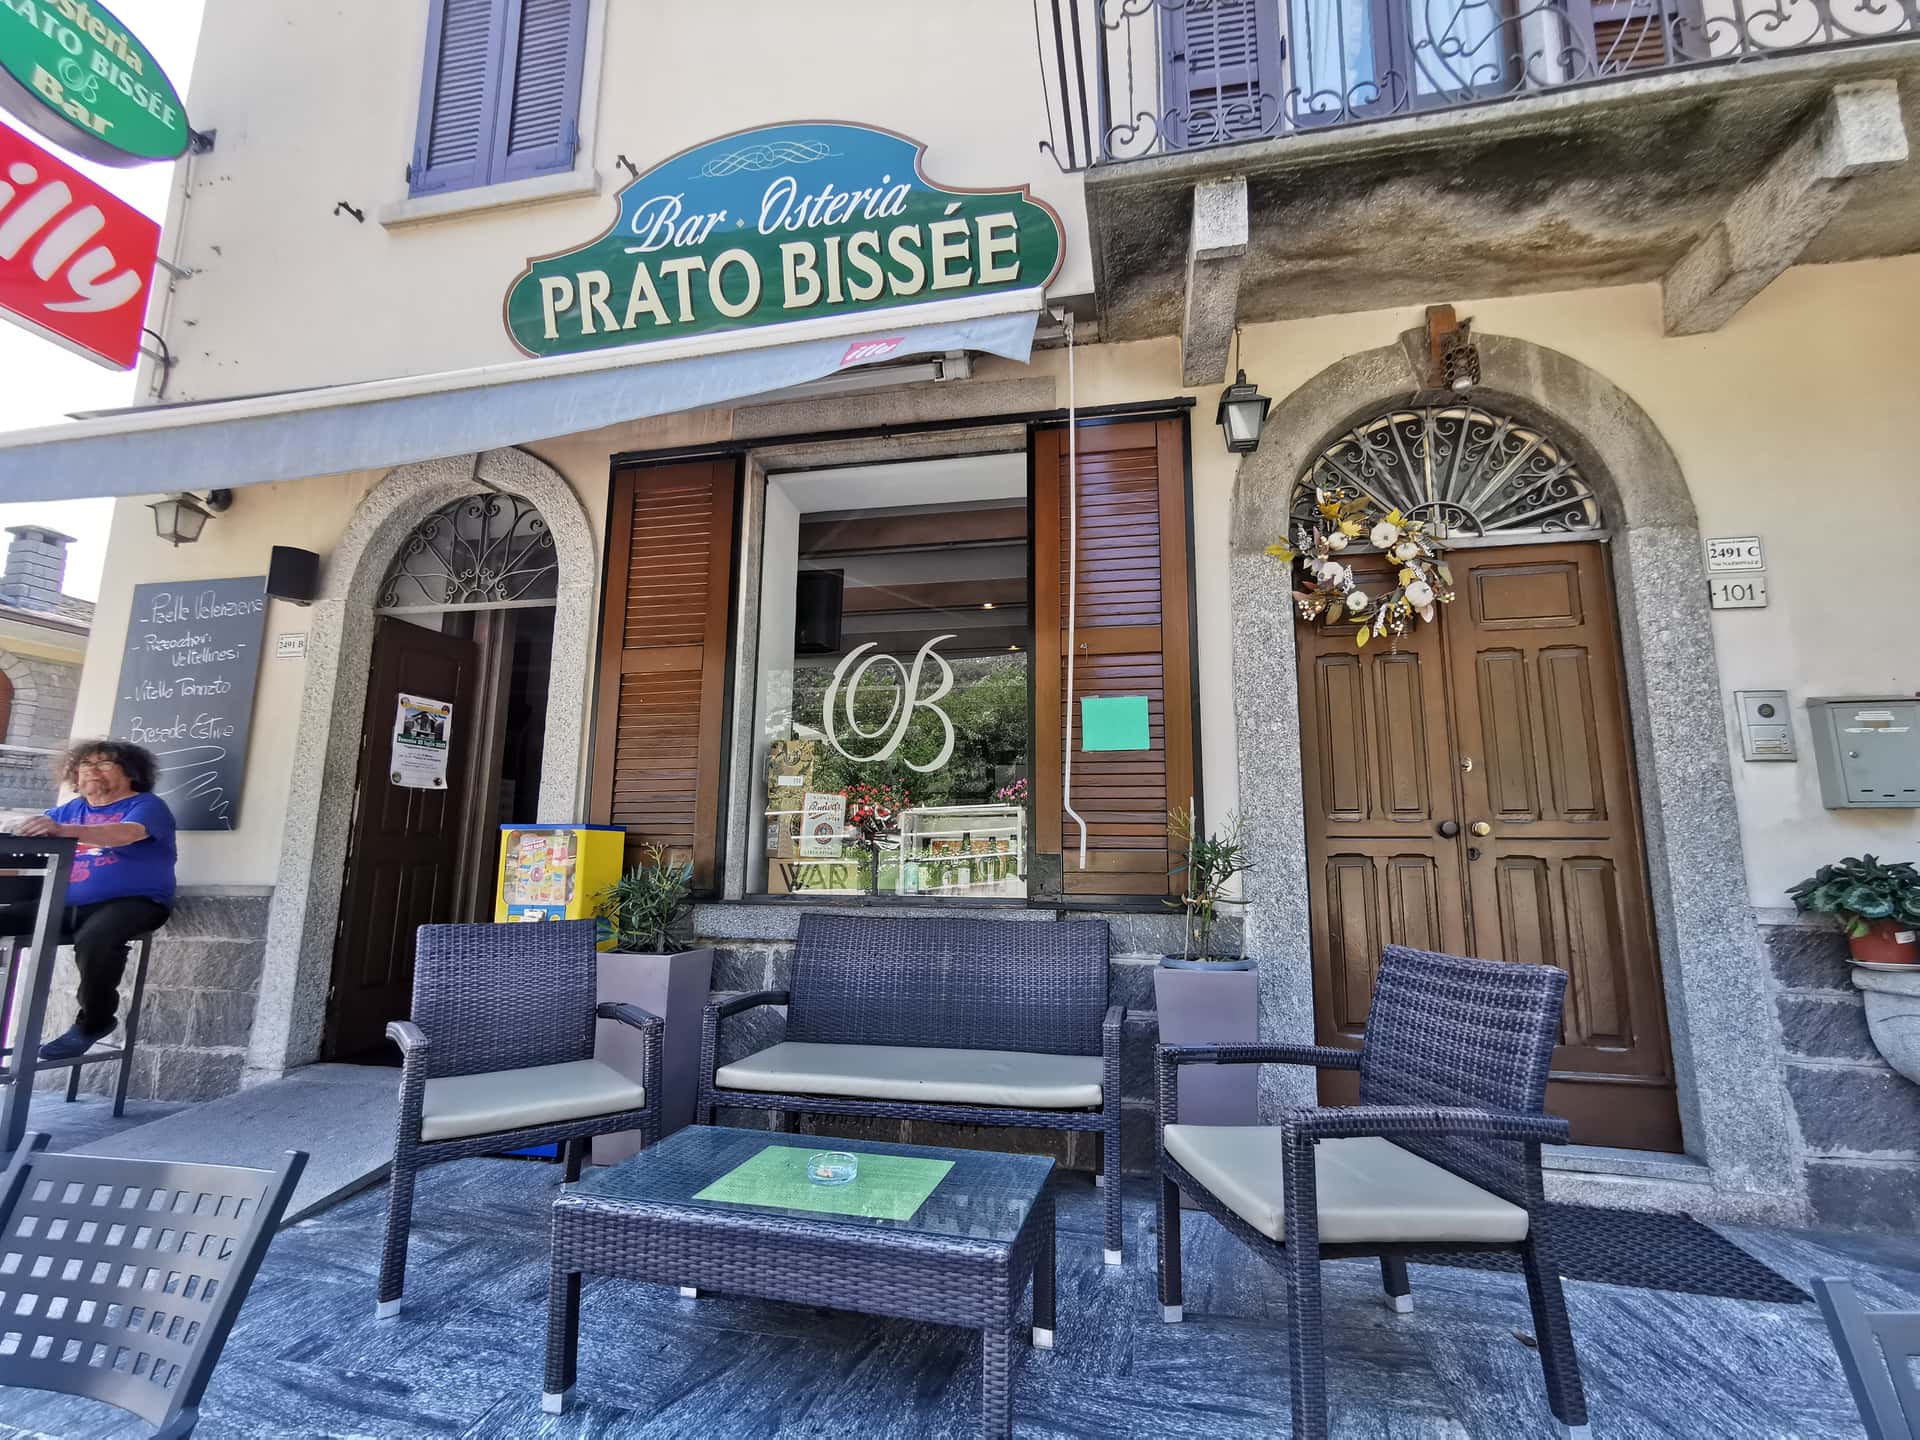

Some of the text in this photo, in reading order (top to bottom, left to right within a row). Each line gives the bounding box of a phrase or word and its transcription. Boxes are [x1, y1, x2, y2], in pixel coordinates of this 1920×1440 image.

[45, 0, 143, 76] steria
[31, 63, 114, 135] Bar
[90, 49, 175, 130] BISSÉE
[624, 174, 912, 254] Bar Osteria
[539, 201, 1021, 340] PRATO BISSÉE
[1710, 546, 1760, 559] 2491 C
[1722, 584, 1755, 602] 101
[136, 679, 174, 701] Vitello
